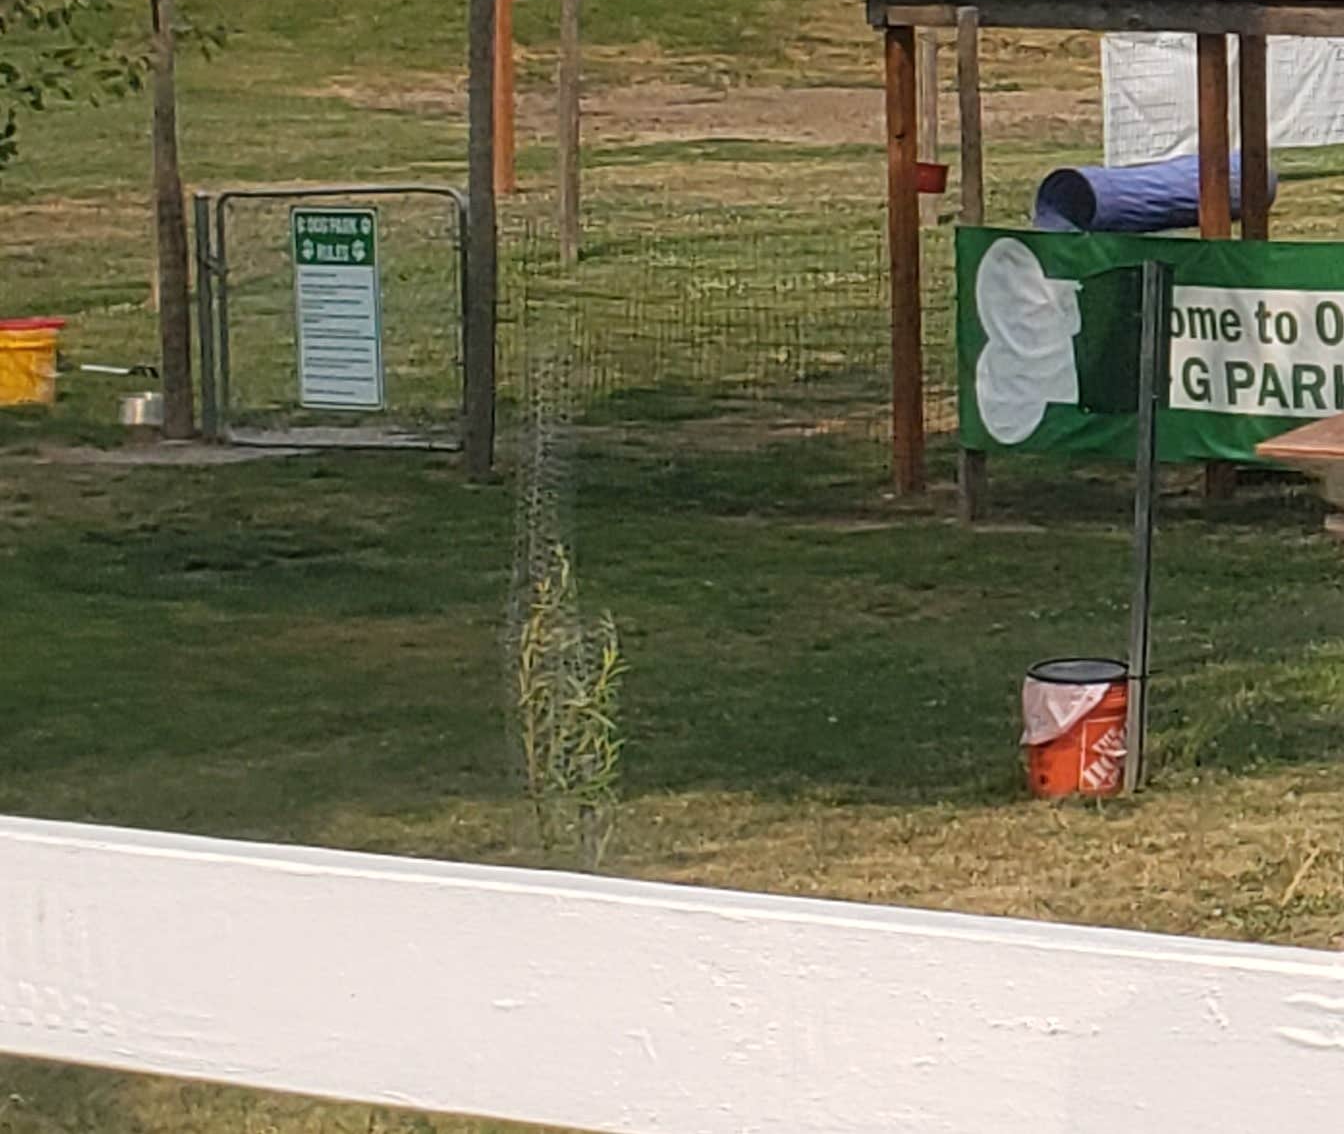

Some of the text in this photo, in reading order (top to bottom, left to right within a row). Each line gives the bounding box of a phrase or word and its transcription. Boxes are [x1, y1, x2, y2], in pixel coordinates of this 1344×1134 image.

[316, 243, 350, 262] RULES
[1168, 306, 1242, 343] ome
[1254, 300, 1298, 345] to
